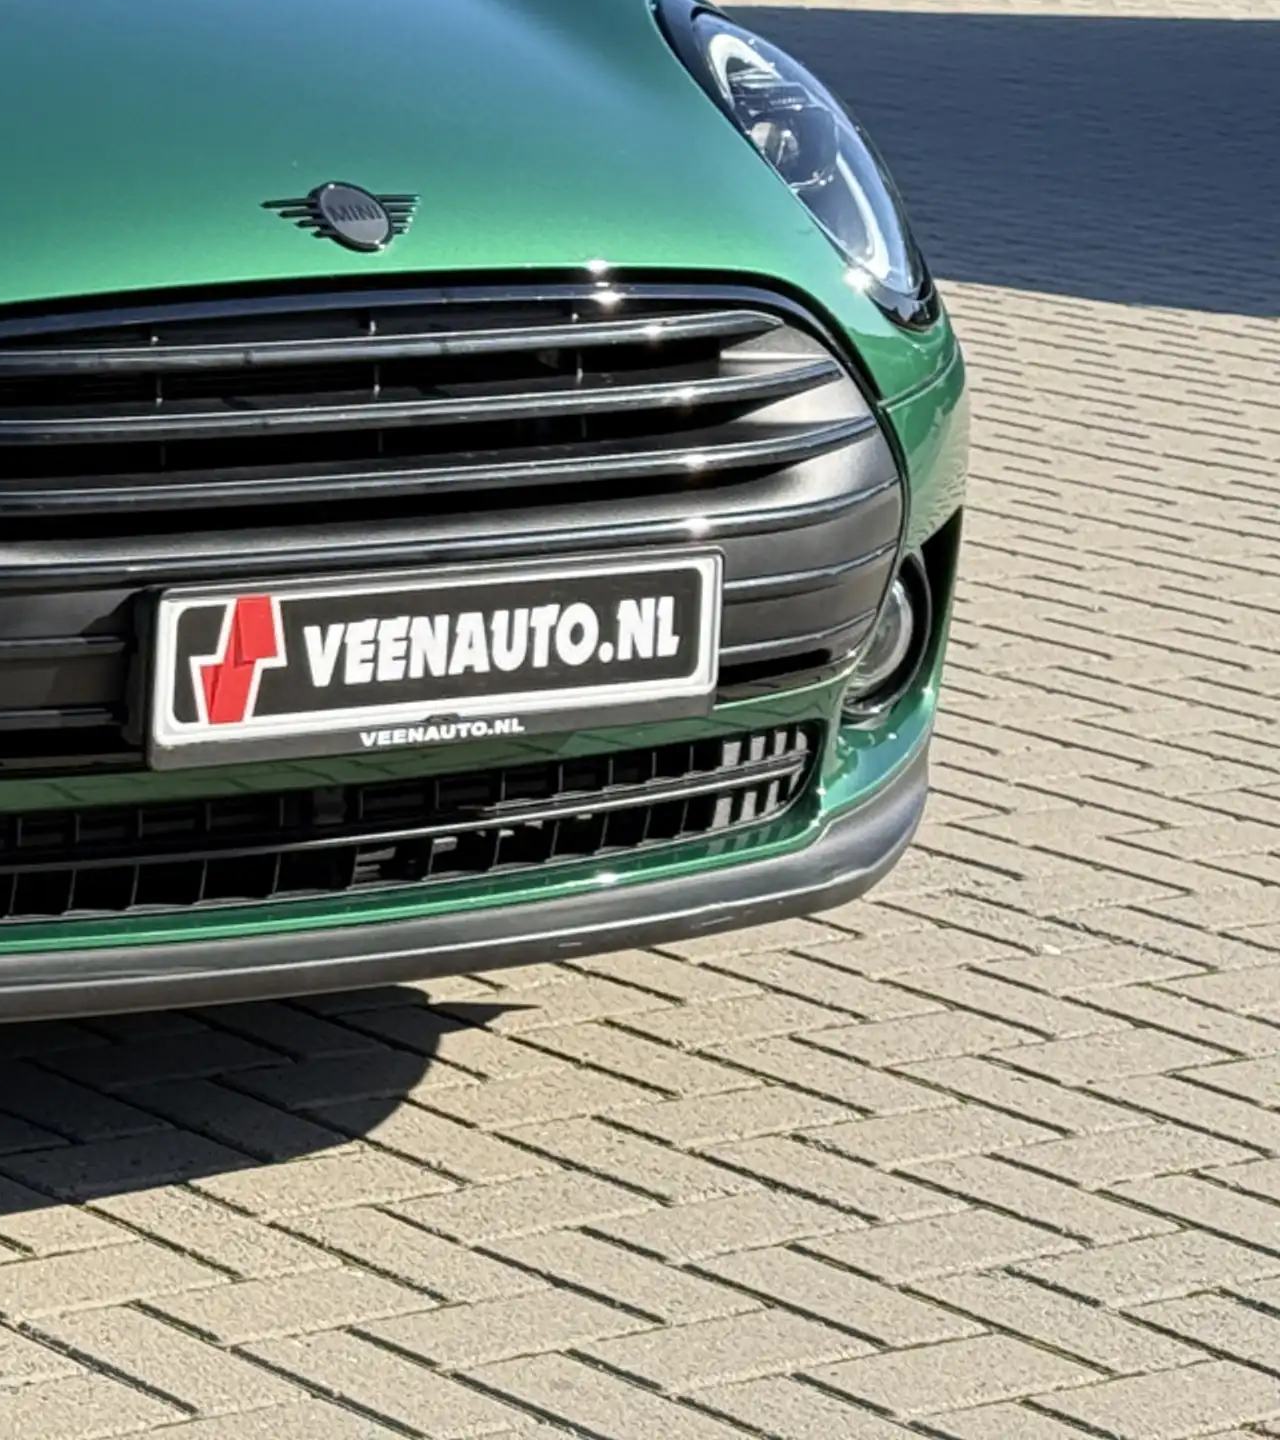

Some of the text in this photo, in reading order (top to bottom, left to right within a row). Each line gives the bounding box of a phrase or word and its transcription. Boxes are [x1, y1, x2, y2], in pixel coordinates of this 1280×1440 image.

[328, 203, 384, 222] MINI
[303, 595, 680, 688] VEENAUTO.NL
[360, 717, 525, 747] VEENAUTO.NL
